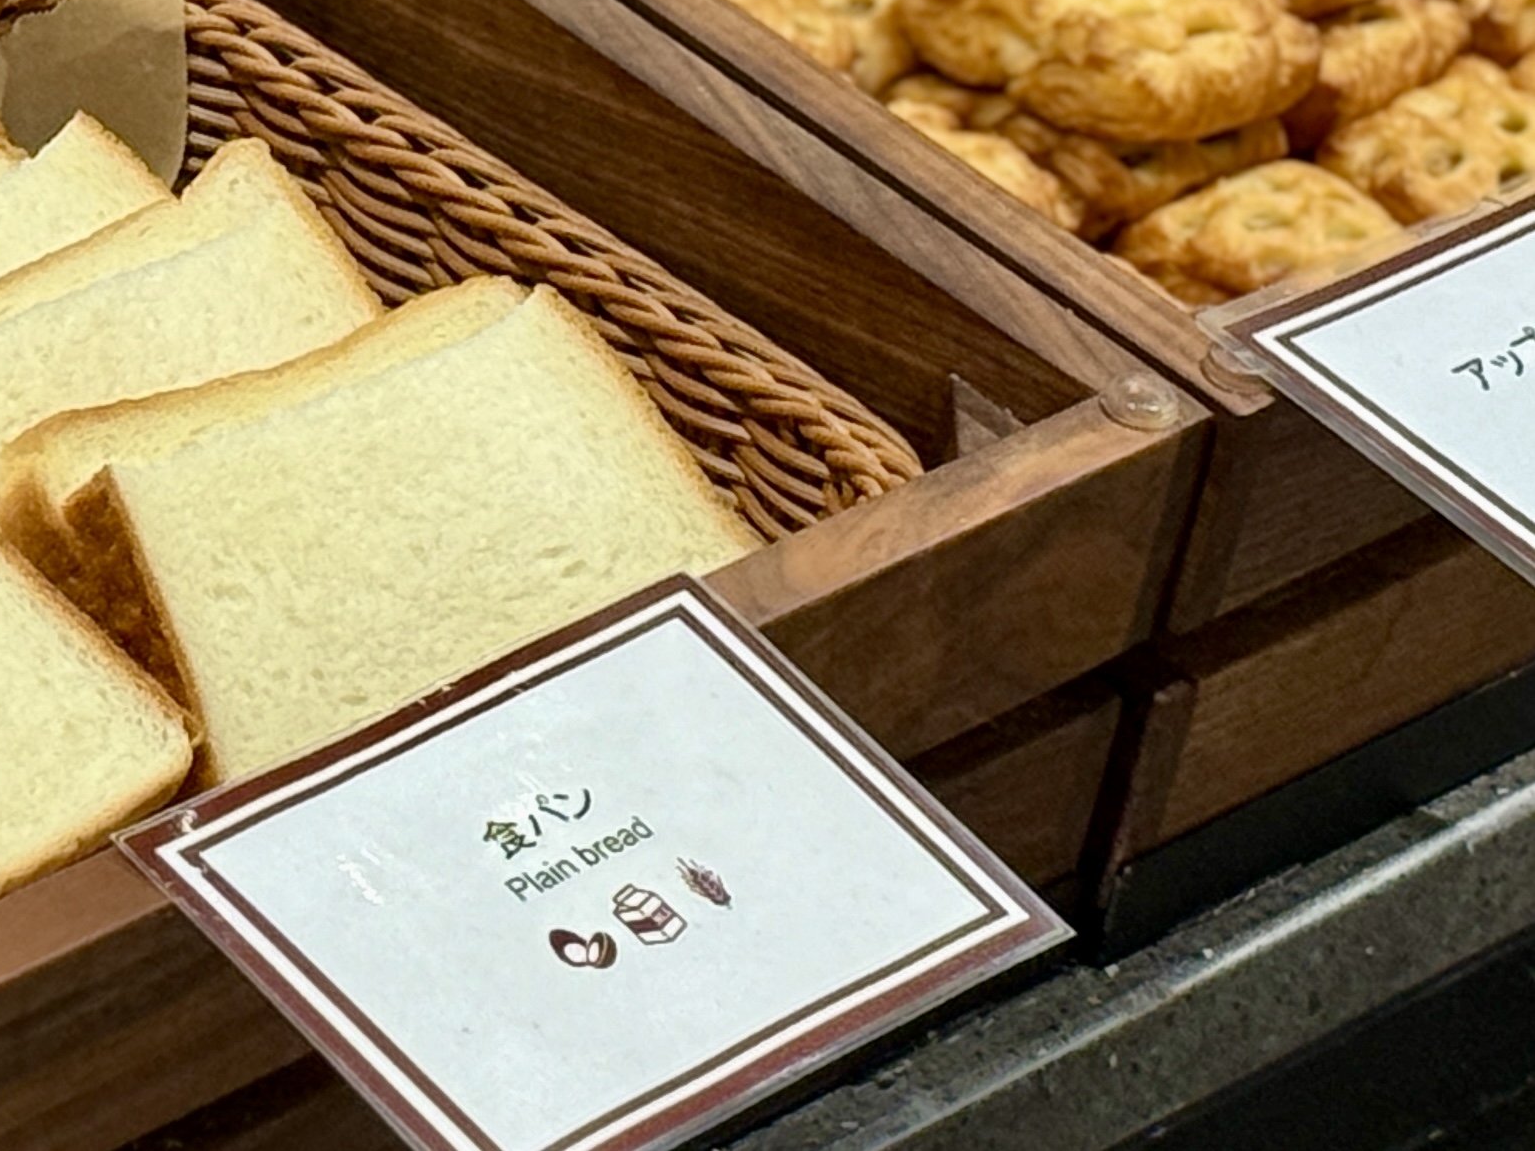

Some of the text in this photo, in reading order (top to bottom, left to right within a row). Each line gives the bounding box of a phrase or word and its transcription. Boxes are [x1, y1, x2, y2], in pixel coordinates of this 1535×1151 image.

[482, 787, 592, 860] 食パン
[504, 815, 655, 902] Plain bread
